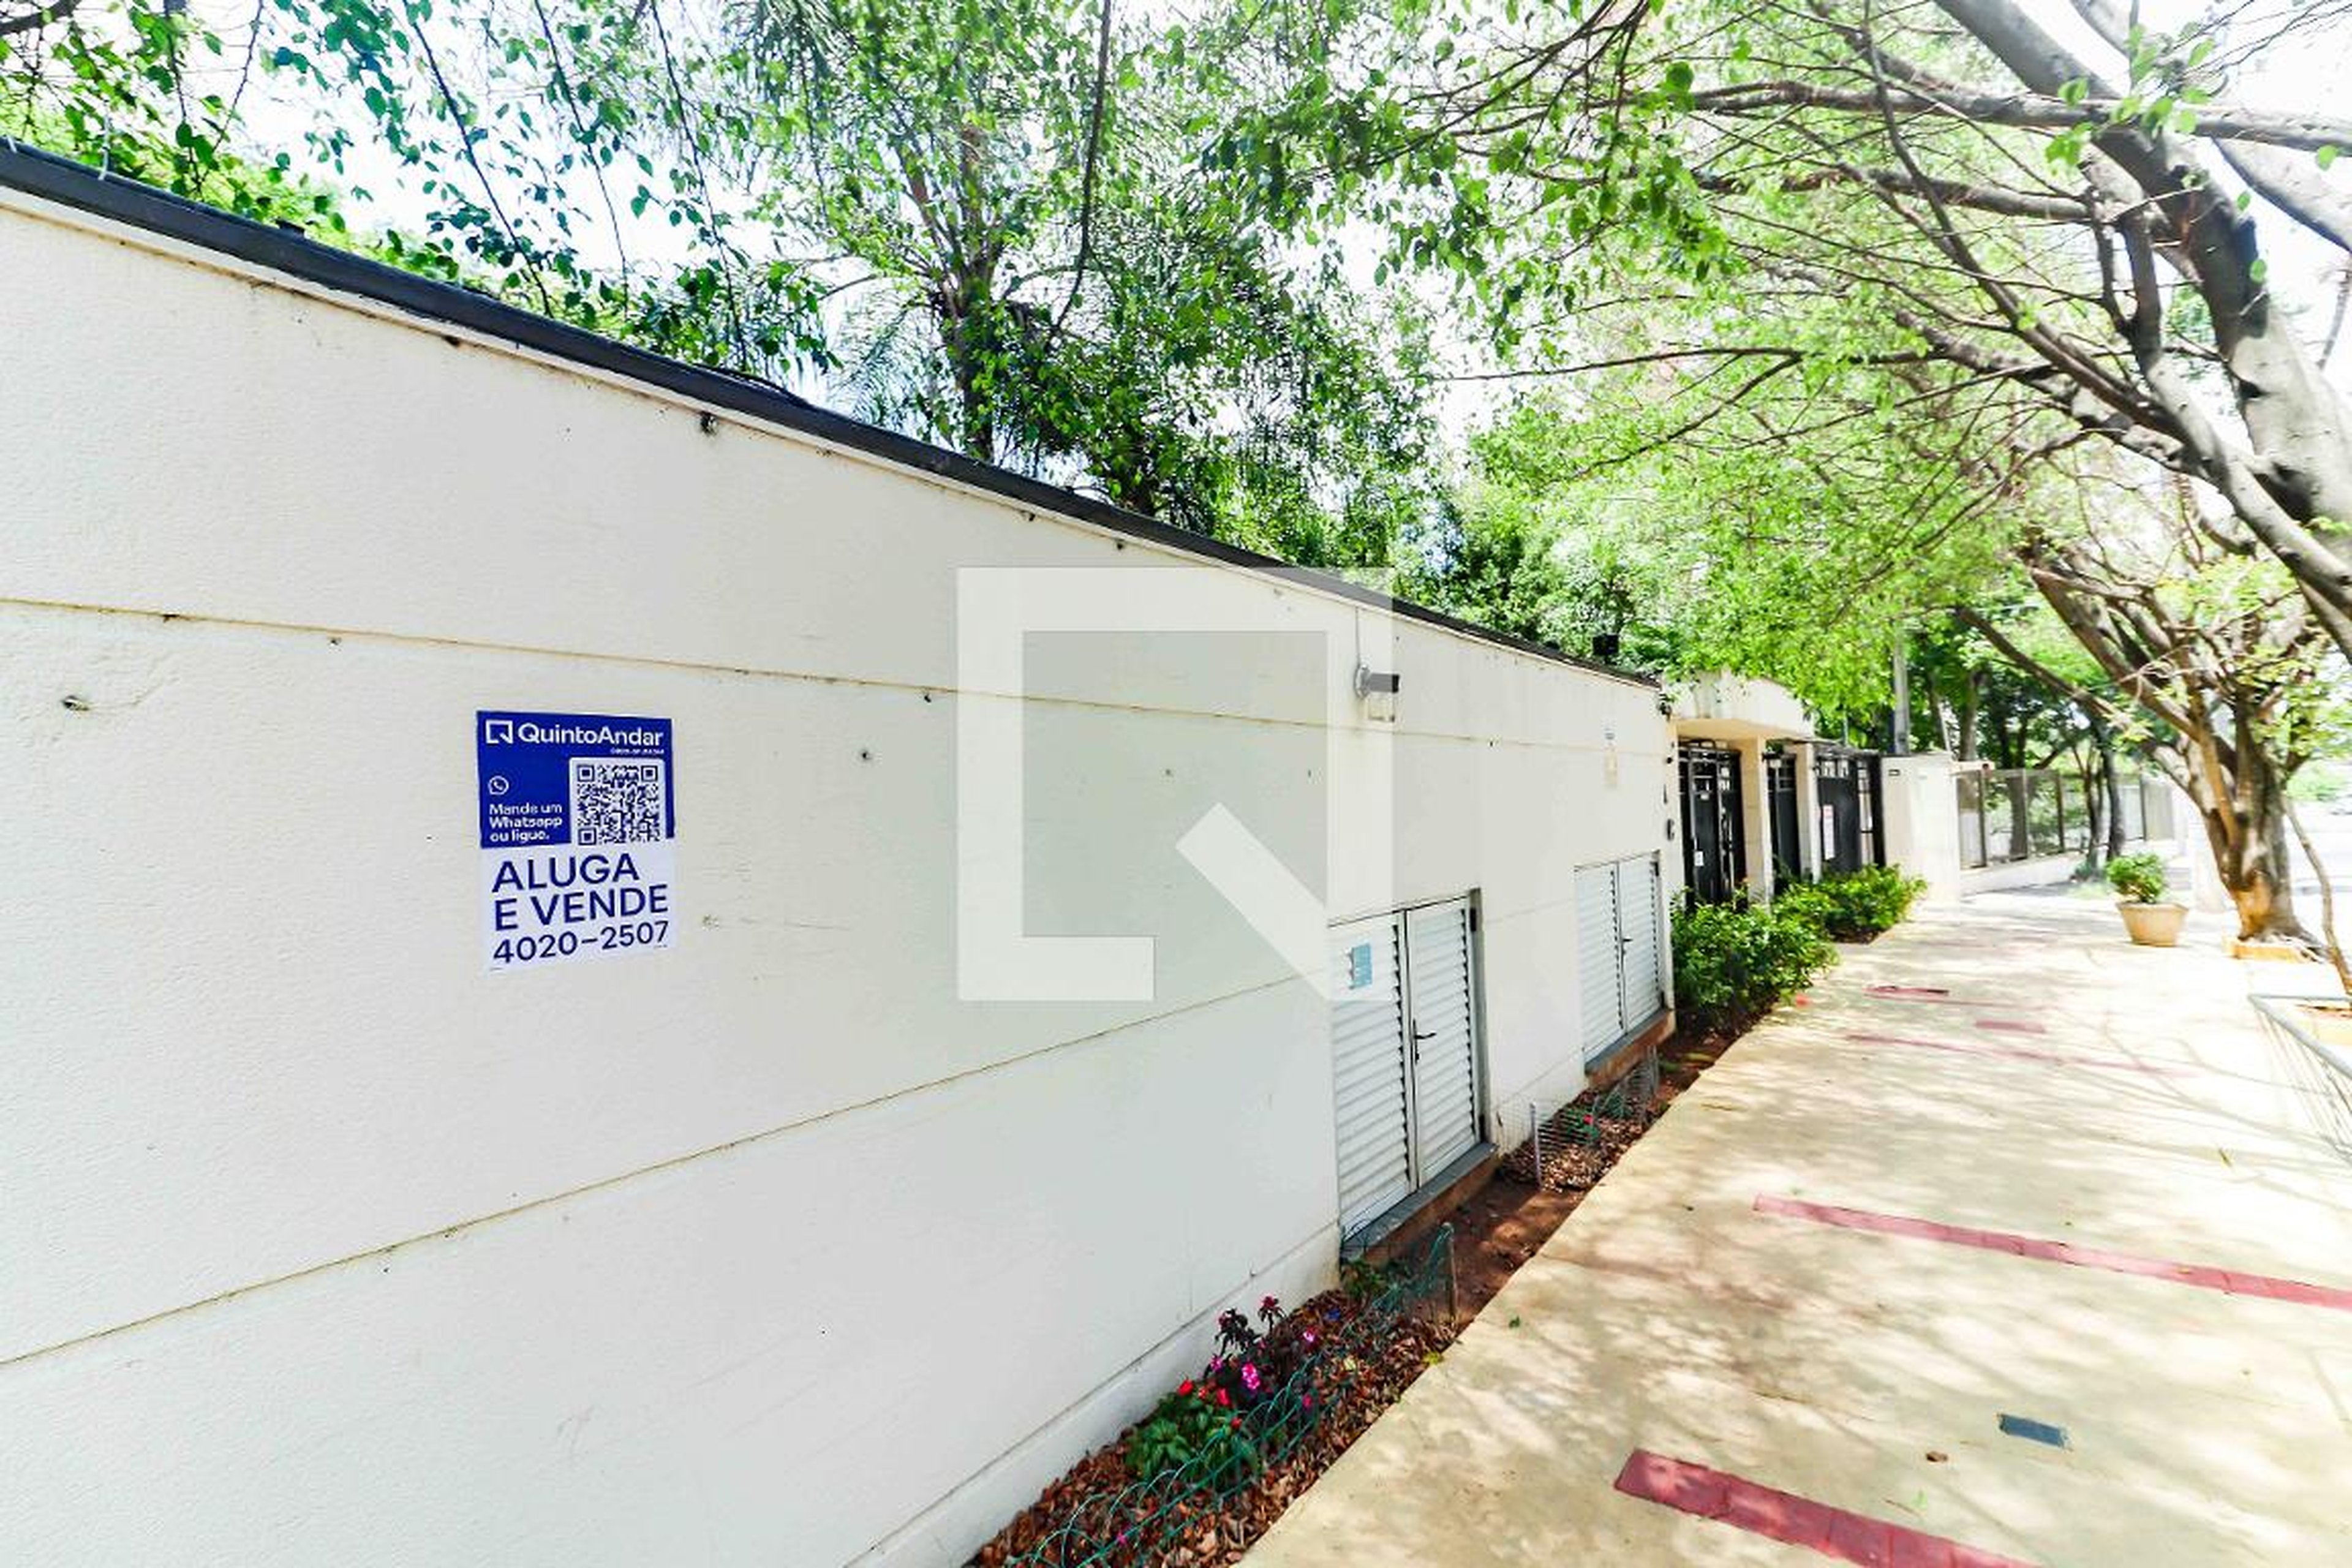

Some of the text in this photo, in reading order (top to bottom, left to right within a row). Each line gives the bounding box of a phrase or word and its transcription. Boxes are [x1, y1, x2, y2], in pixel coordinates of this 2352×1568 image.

[518, 723, 663, 746] QuintoAndar
[489, 802, 563, 815] Mande um
[489, 832, 509, 842] ou
[491, 853, 640, 893] ALUGA
[494, 884, 669, 932] E VENDE
[492, 920, 669, 963] 4020-2507
